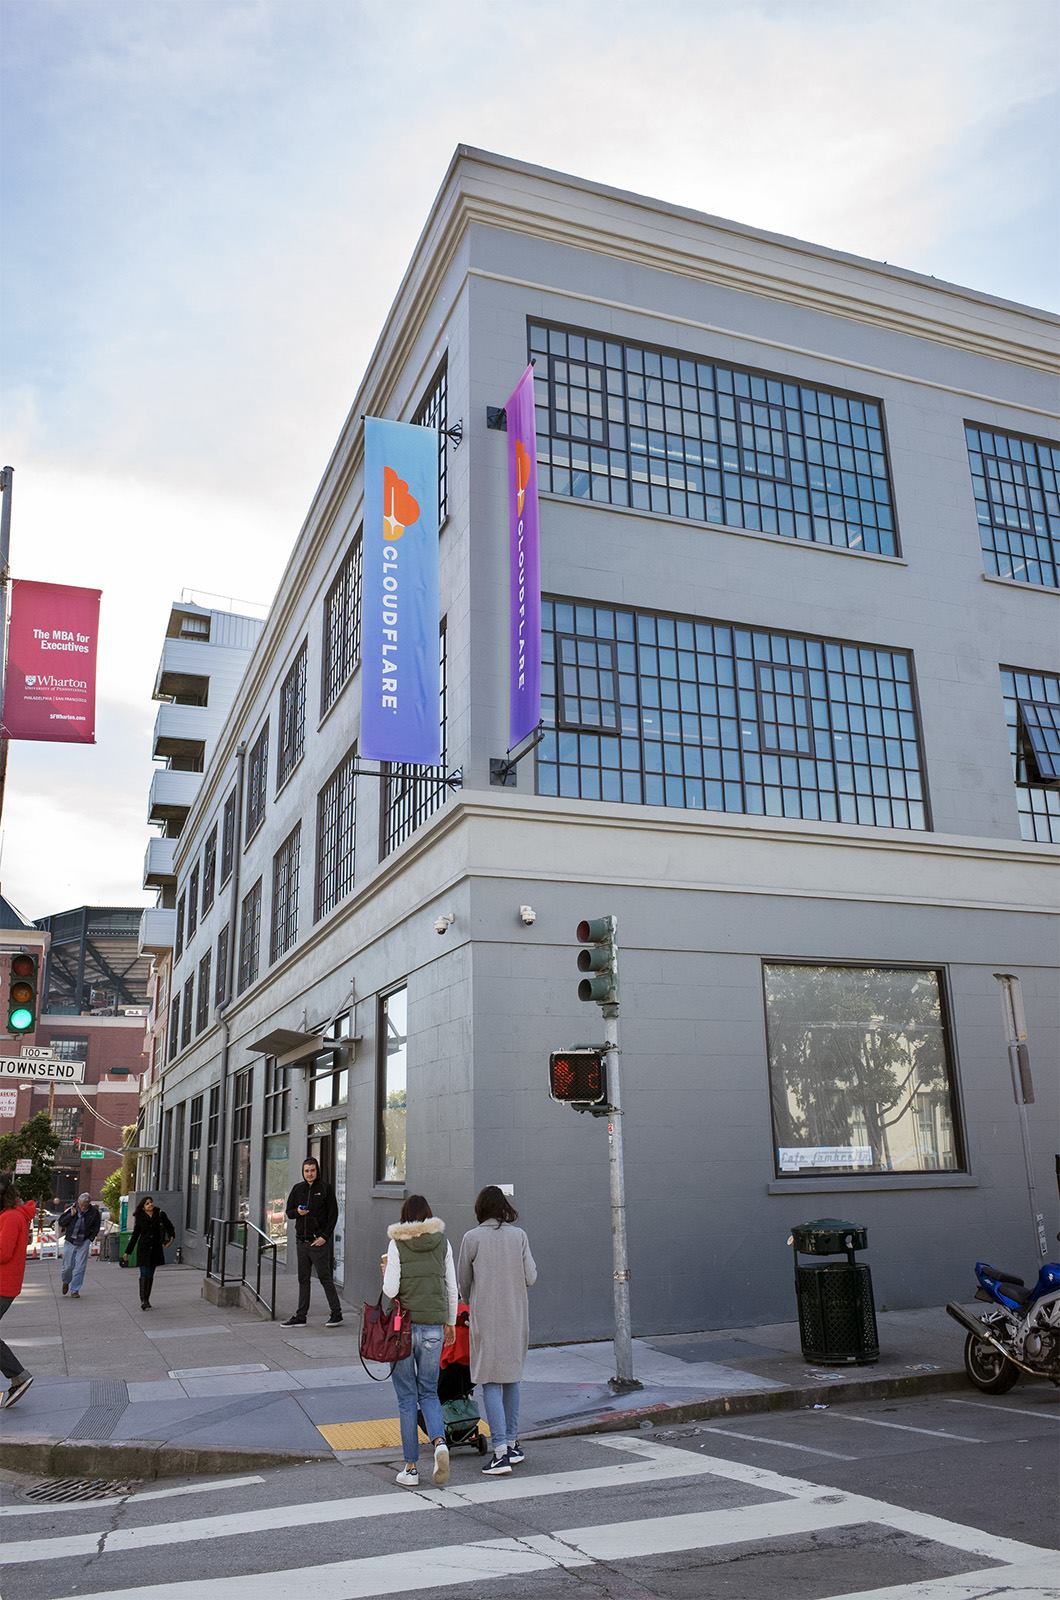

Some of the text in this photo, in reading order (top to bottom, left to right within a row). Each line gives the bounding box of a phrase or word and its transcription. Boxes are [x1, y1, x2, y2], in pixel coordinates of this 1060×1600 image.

[381, 545, 398, 709] CLOUDFLARE
[33, 629, 90, 643] The MBA for
[41, 640, 89, 653] Executives
[37, 675, 87, 688] Wharton
[50, 713, 86, 721] SFWharton.com
[25, 1048, 40, 1057] 100
[0, 1061, 75, 1078] TOWNSEND
